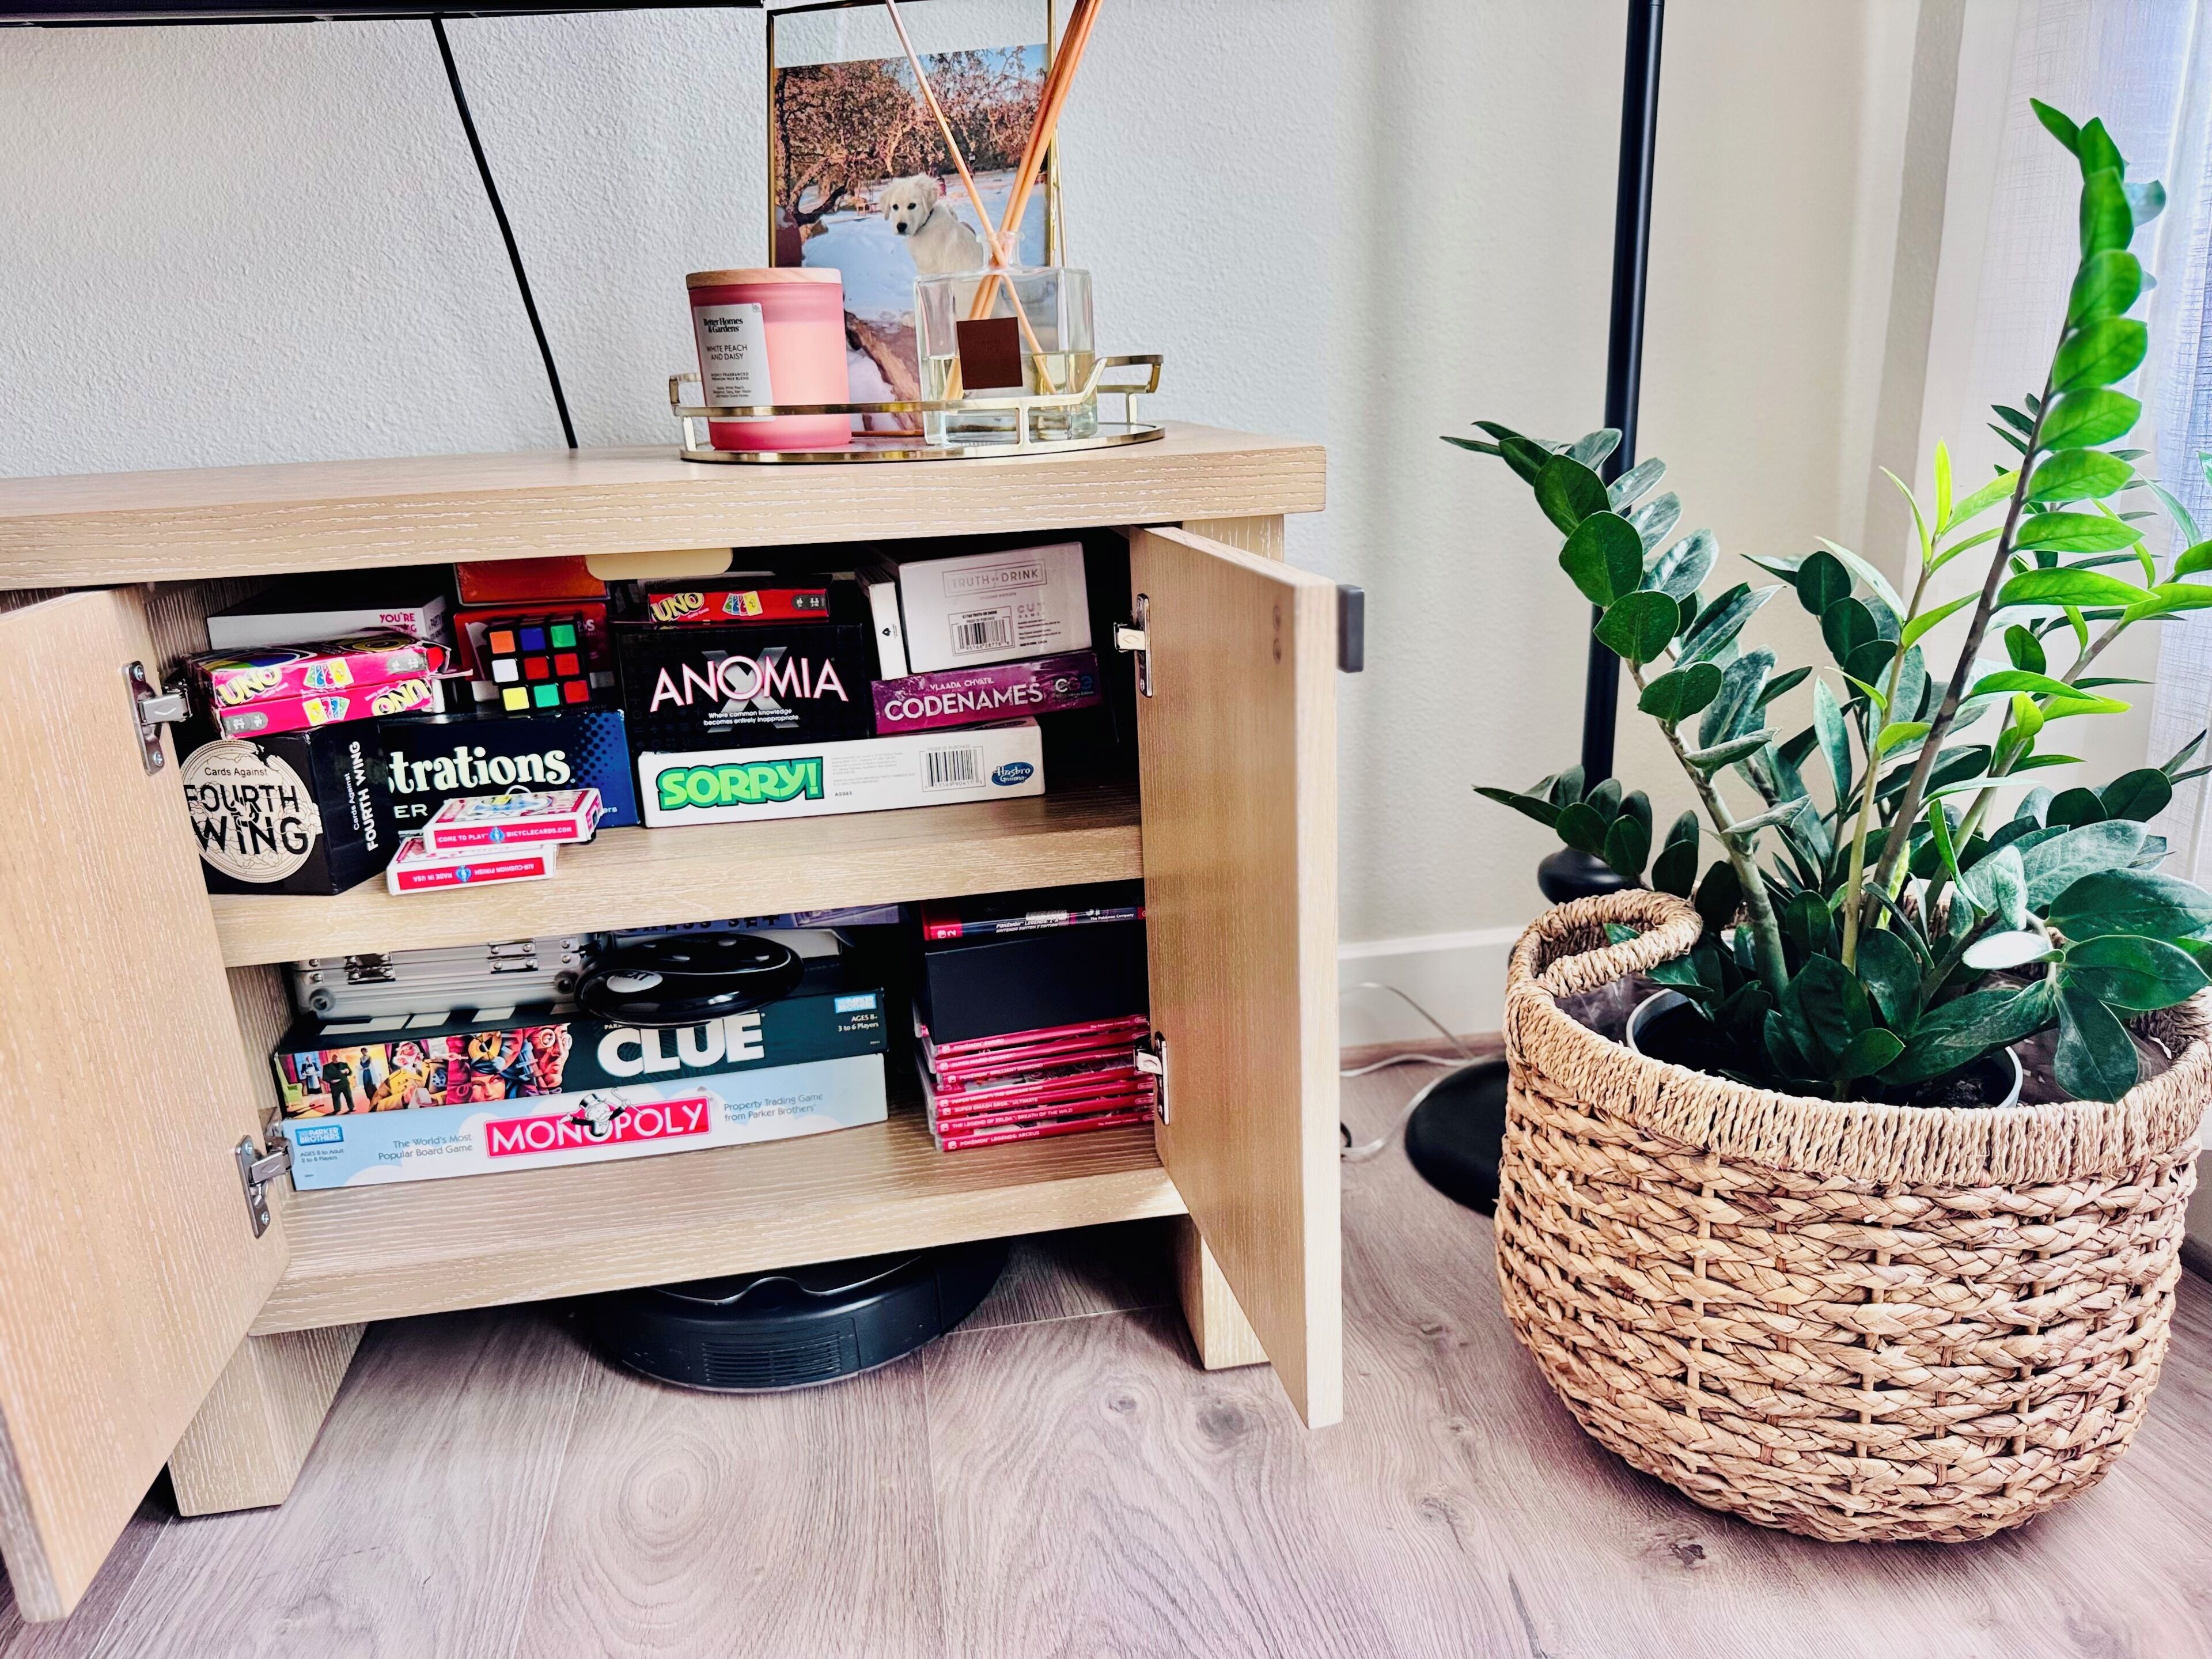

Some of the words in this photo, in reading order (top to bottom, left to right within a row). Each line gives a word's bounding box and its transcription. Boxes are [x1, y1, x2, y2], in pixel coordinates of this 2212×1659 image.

[703, 318, 719, 327] Better
[719, 317, 743, 325] Homes
[952, 575, 990, 588] TRUTH
[1001, 569, 1039, 582] DRINK
[380, 612, 415, 623] YOU'RE
[651, 592, 703, 622] UNO
[217, 668, 281, 705] UNO
[373, 679, 431, 716] UNO
[650, 655, 849, 713] ANOMIA
[930, 682, 961, 691] VLAADA
[884, 683, 1043, 721] CODENAMES
[757, 714, 801, 722] inappropriate.
[204, 767, 232, 777] Cards
[234, 767, 268, 779] Against
[349, 741, 366, 787] WING
[388, 745, 571, 794] trations
[993, 766, 1031, 777] Hasbro
[344, 772, 357, 803] Against
[661, 762, 819, 806] SORRY!
[183, 785, 300, 813] FOURTH
[352, 803, 360, 831] Cards
[357, 787, 379, 851] FOURTH
[191, 816, 309, 855] WING
[506, 827, 572, 838] BICYCLECARDS.COM
[496, 863, 535, 873] AIR-CUSHION
[597, 1013, 765, 1077] CLUE
[724, 1101, 762, 1111] Property
[764, 1096, 796, 1106] Trading
[798, 1093, 823, 1103] Game
[725, 1113, 745, 1122] from
[748, 1109, 775, 1119] Parker
[778, 1105, 815, 1115] Brothers
[393, 1140, 410, 1149] The
[412, 1136, 446, 1146] World's
[449, 1134, 472, 1143] Most
[493, 1103, 703, 1153] MONOPOLY
[378, 1150, 413, 1161] Popular
[416, 1146, 443, 1156] Board
[445, 1144, 473, 1153] Game
